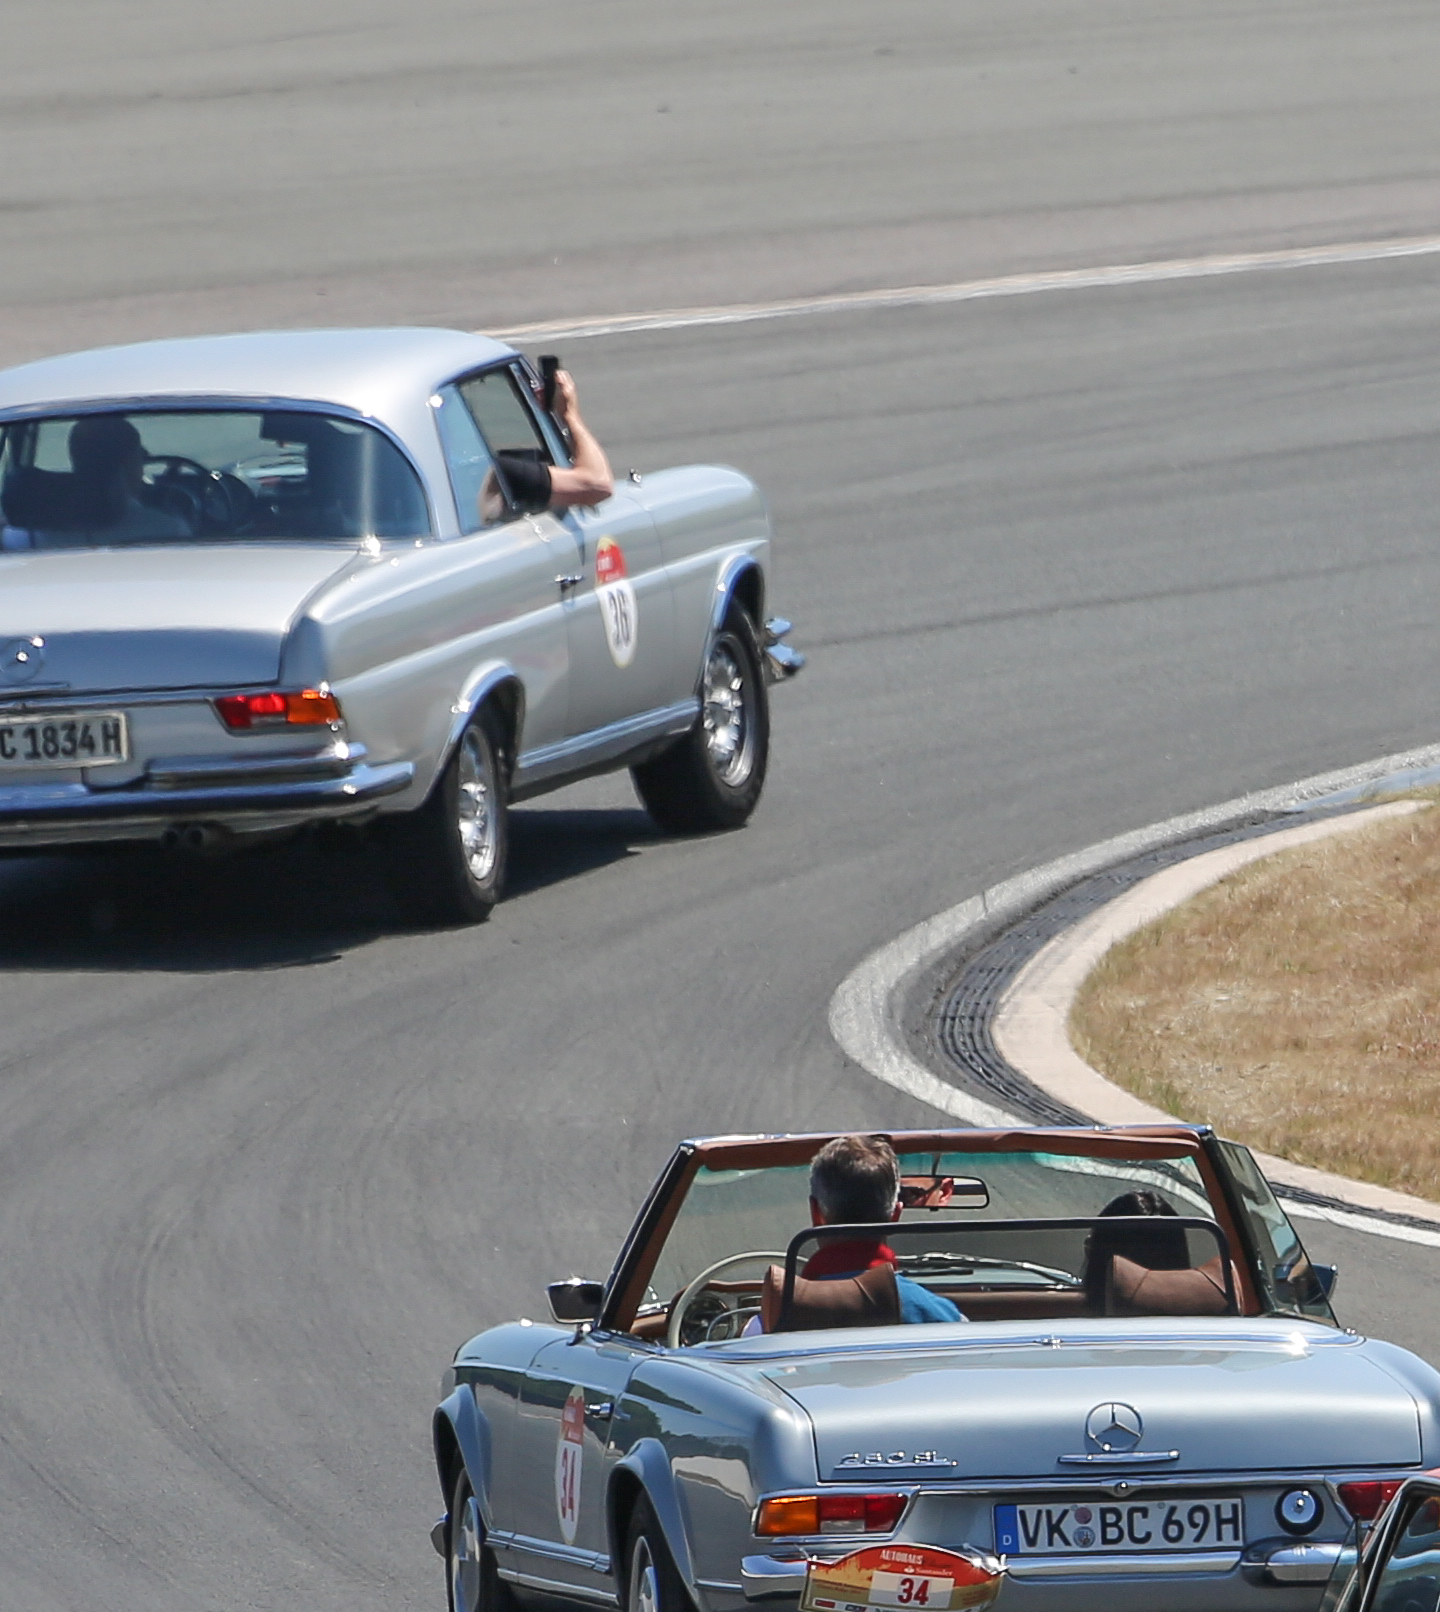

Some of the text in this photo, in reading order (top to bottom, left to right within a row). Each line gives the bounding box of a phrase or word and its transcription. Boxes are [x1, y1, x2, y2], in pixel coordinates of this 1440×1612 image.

[606, 588, 630, 647] 36
[562, 1447, 576, 1522] 34
[1019, 1509, 1072, 1547] VK
[1099, 1506, 1153, 1545] BC
[1162, 1503, 1241, 1544] 69H
[897, 1578, 930, 1606] 34
